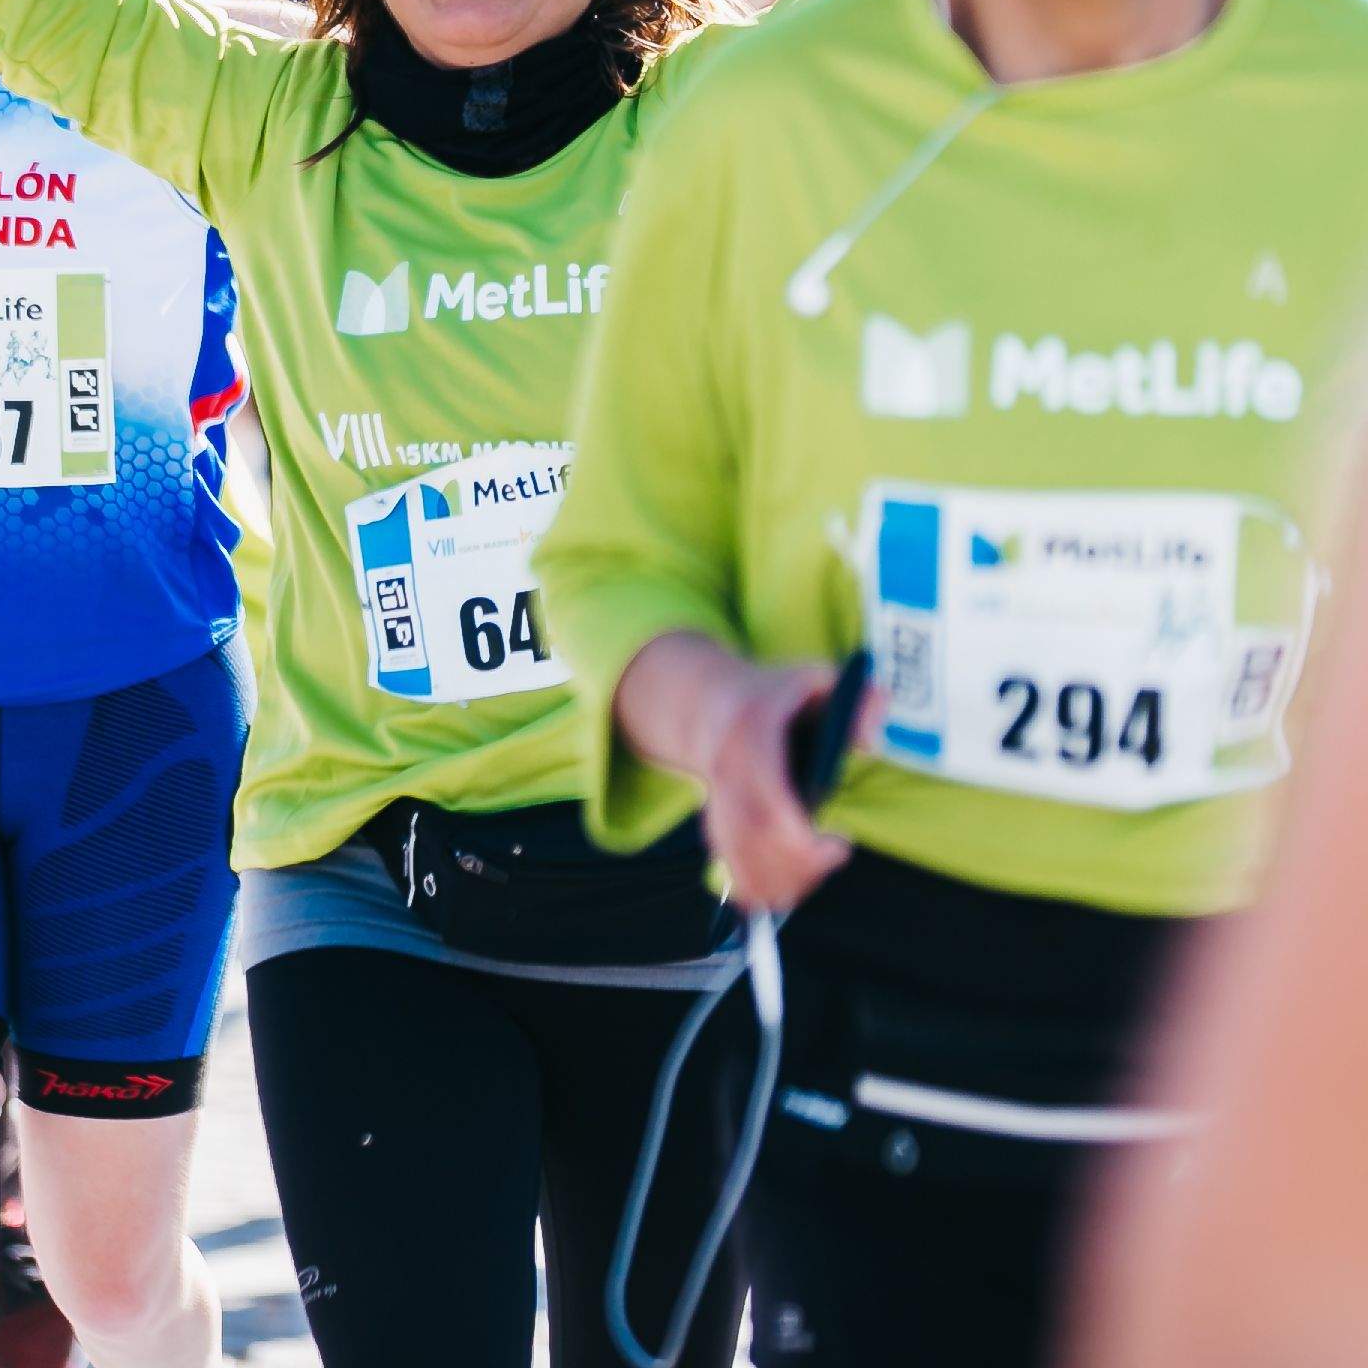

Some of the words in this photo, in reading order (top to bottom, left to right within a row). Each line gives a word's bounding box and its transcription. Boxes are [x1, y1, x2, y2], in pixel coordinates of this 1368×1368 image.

[423, 262, 610, 322] MetLif
[989, 331, 1304, 422] MetLife
[318, 412, 392, 471] VIII
[396, 443, 463, 466] 15KM
[473, 463, 571, 508] MetLif
[428, 537, 456, 557] VIII
[997, 674, 1165, 769] 294
